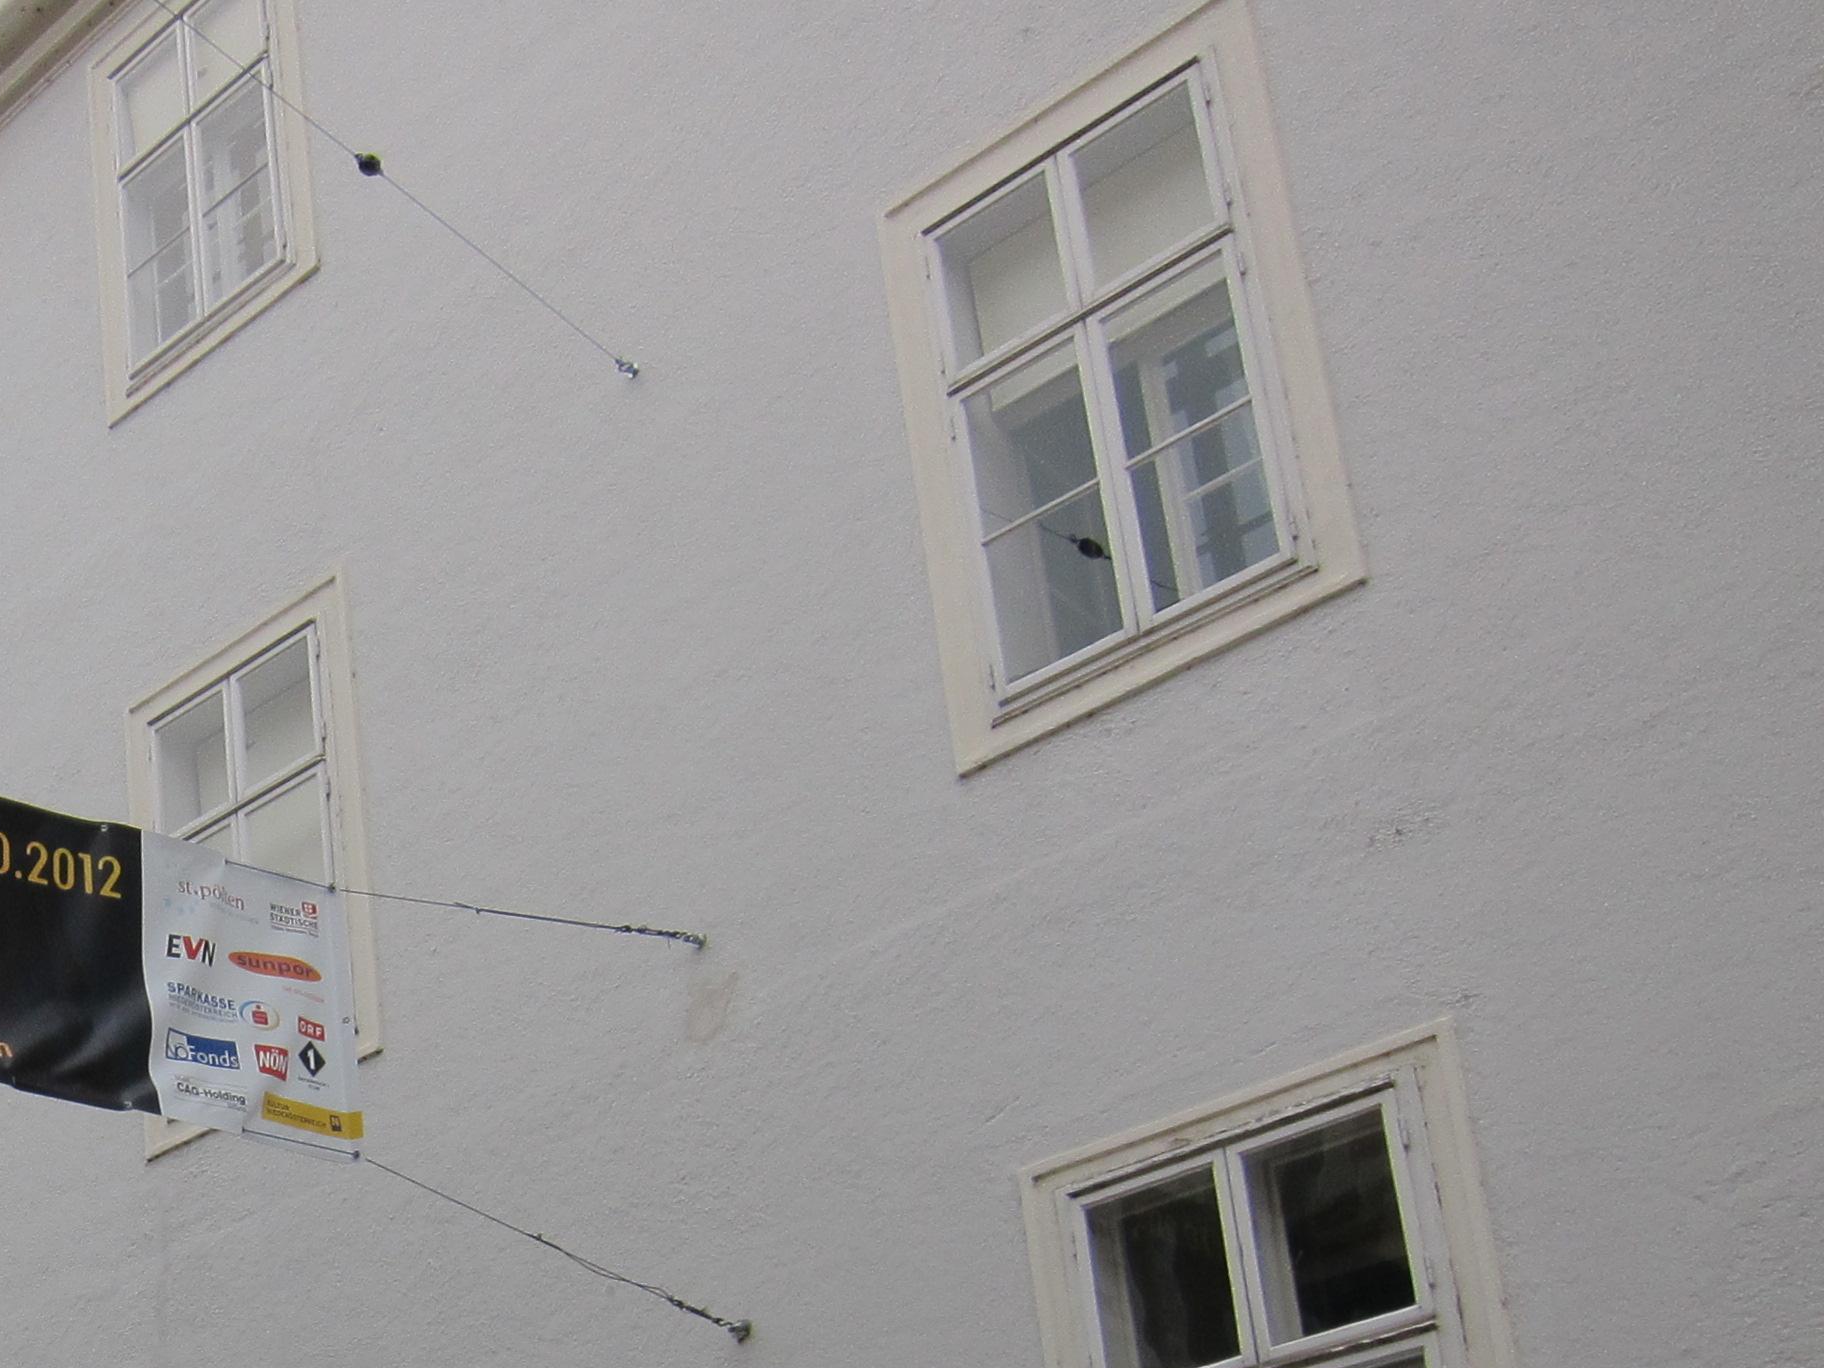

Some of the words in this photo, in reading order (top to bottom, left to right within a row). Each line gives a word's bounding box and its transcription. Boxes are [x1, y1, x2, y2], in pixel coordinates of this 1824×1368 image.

[166, 933, 216, 968] EVN
[237, 955, 314, 977] sunpor
[167, 982, 237, 1011] SPARKASSE
[299, 1020, 323, 1038] ORF
[259, 1049, 287, 1074] NÖN
